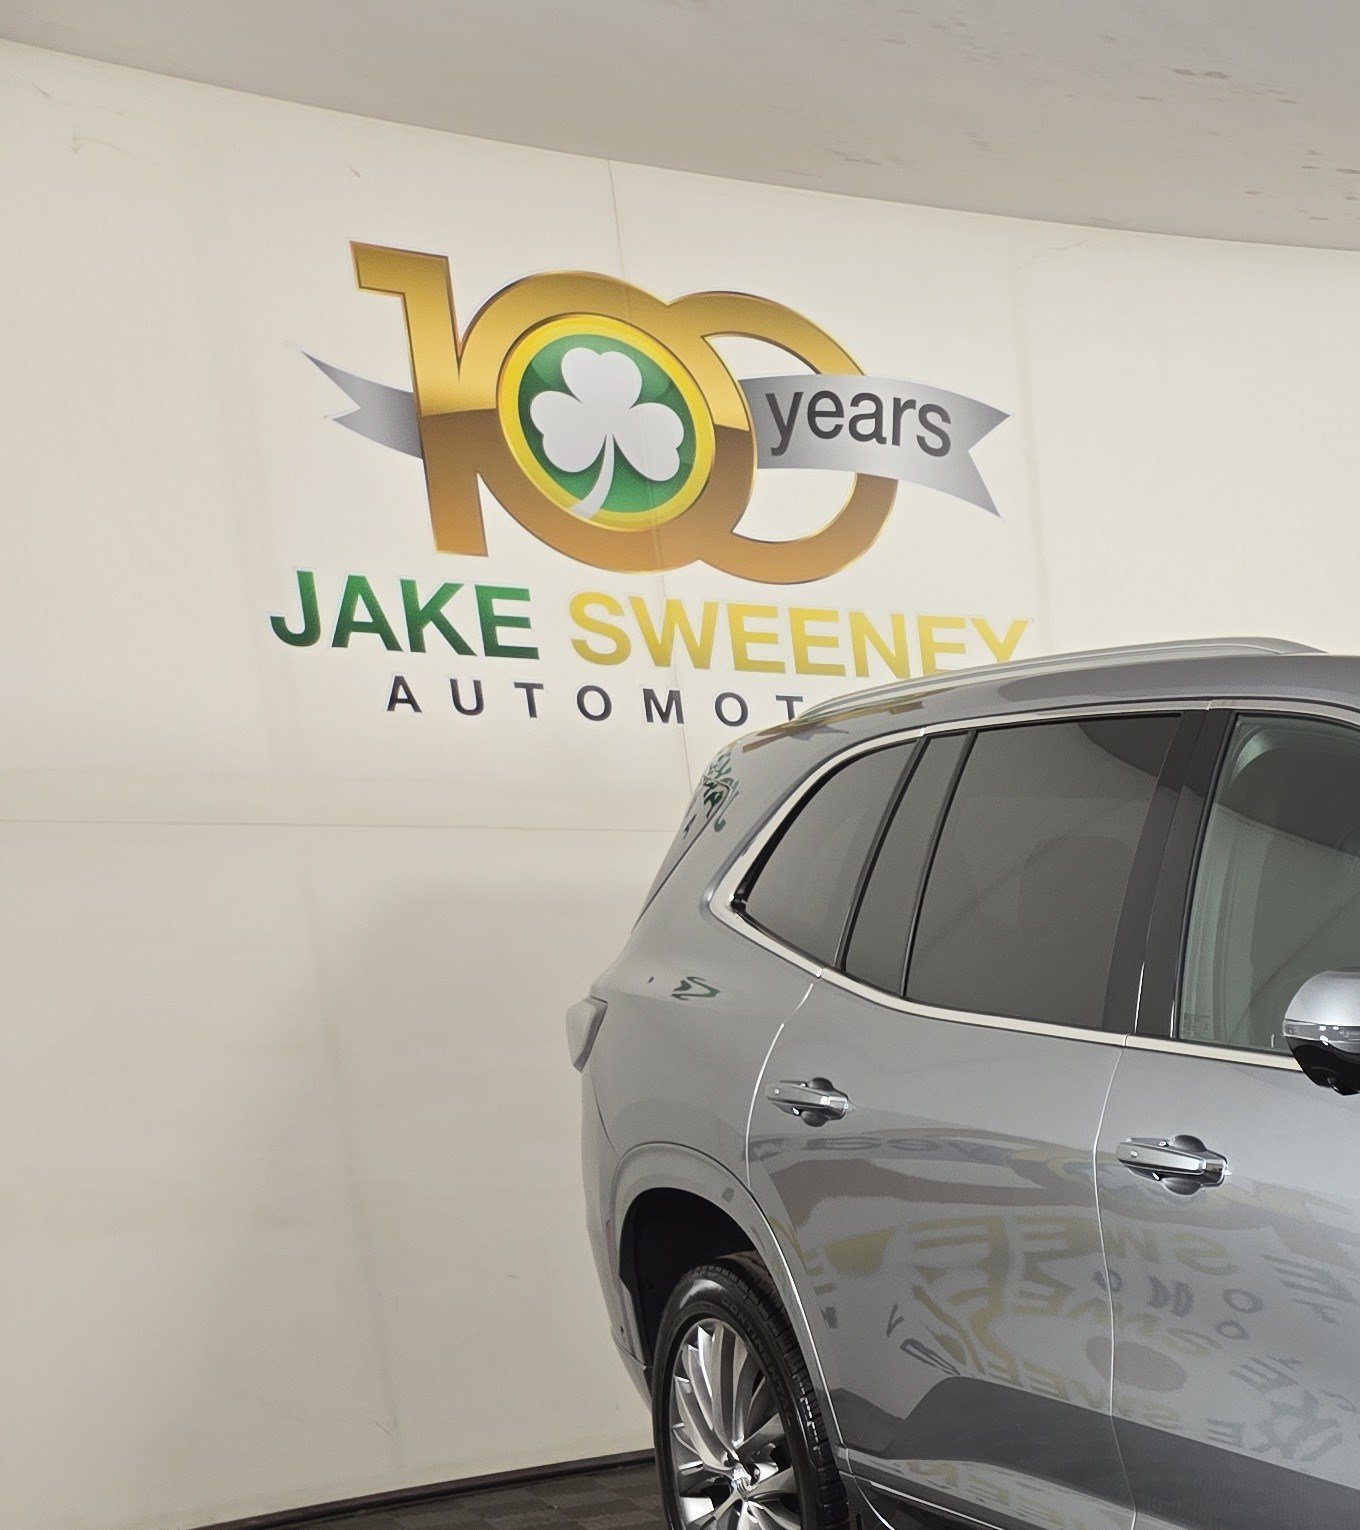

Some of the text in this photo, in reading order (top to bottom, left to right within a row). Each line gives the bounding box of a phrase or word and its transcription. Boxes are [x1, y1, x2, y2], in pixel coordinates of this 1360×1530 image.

[350, 241, 953, 586] 100 years
[270, 569, 1030, 680] JAKE SWEENEY
[387, 675, 805, 727] AUTOMOT
